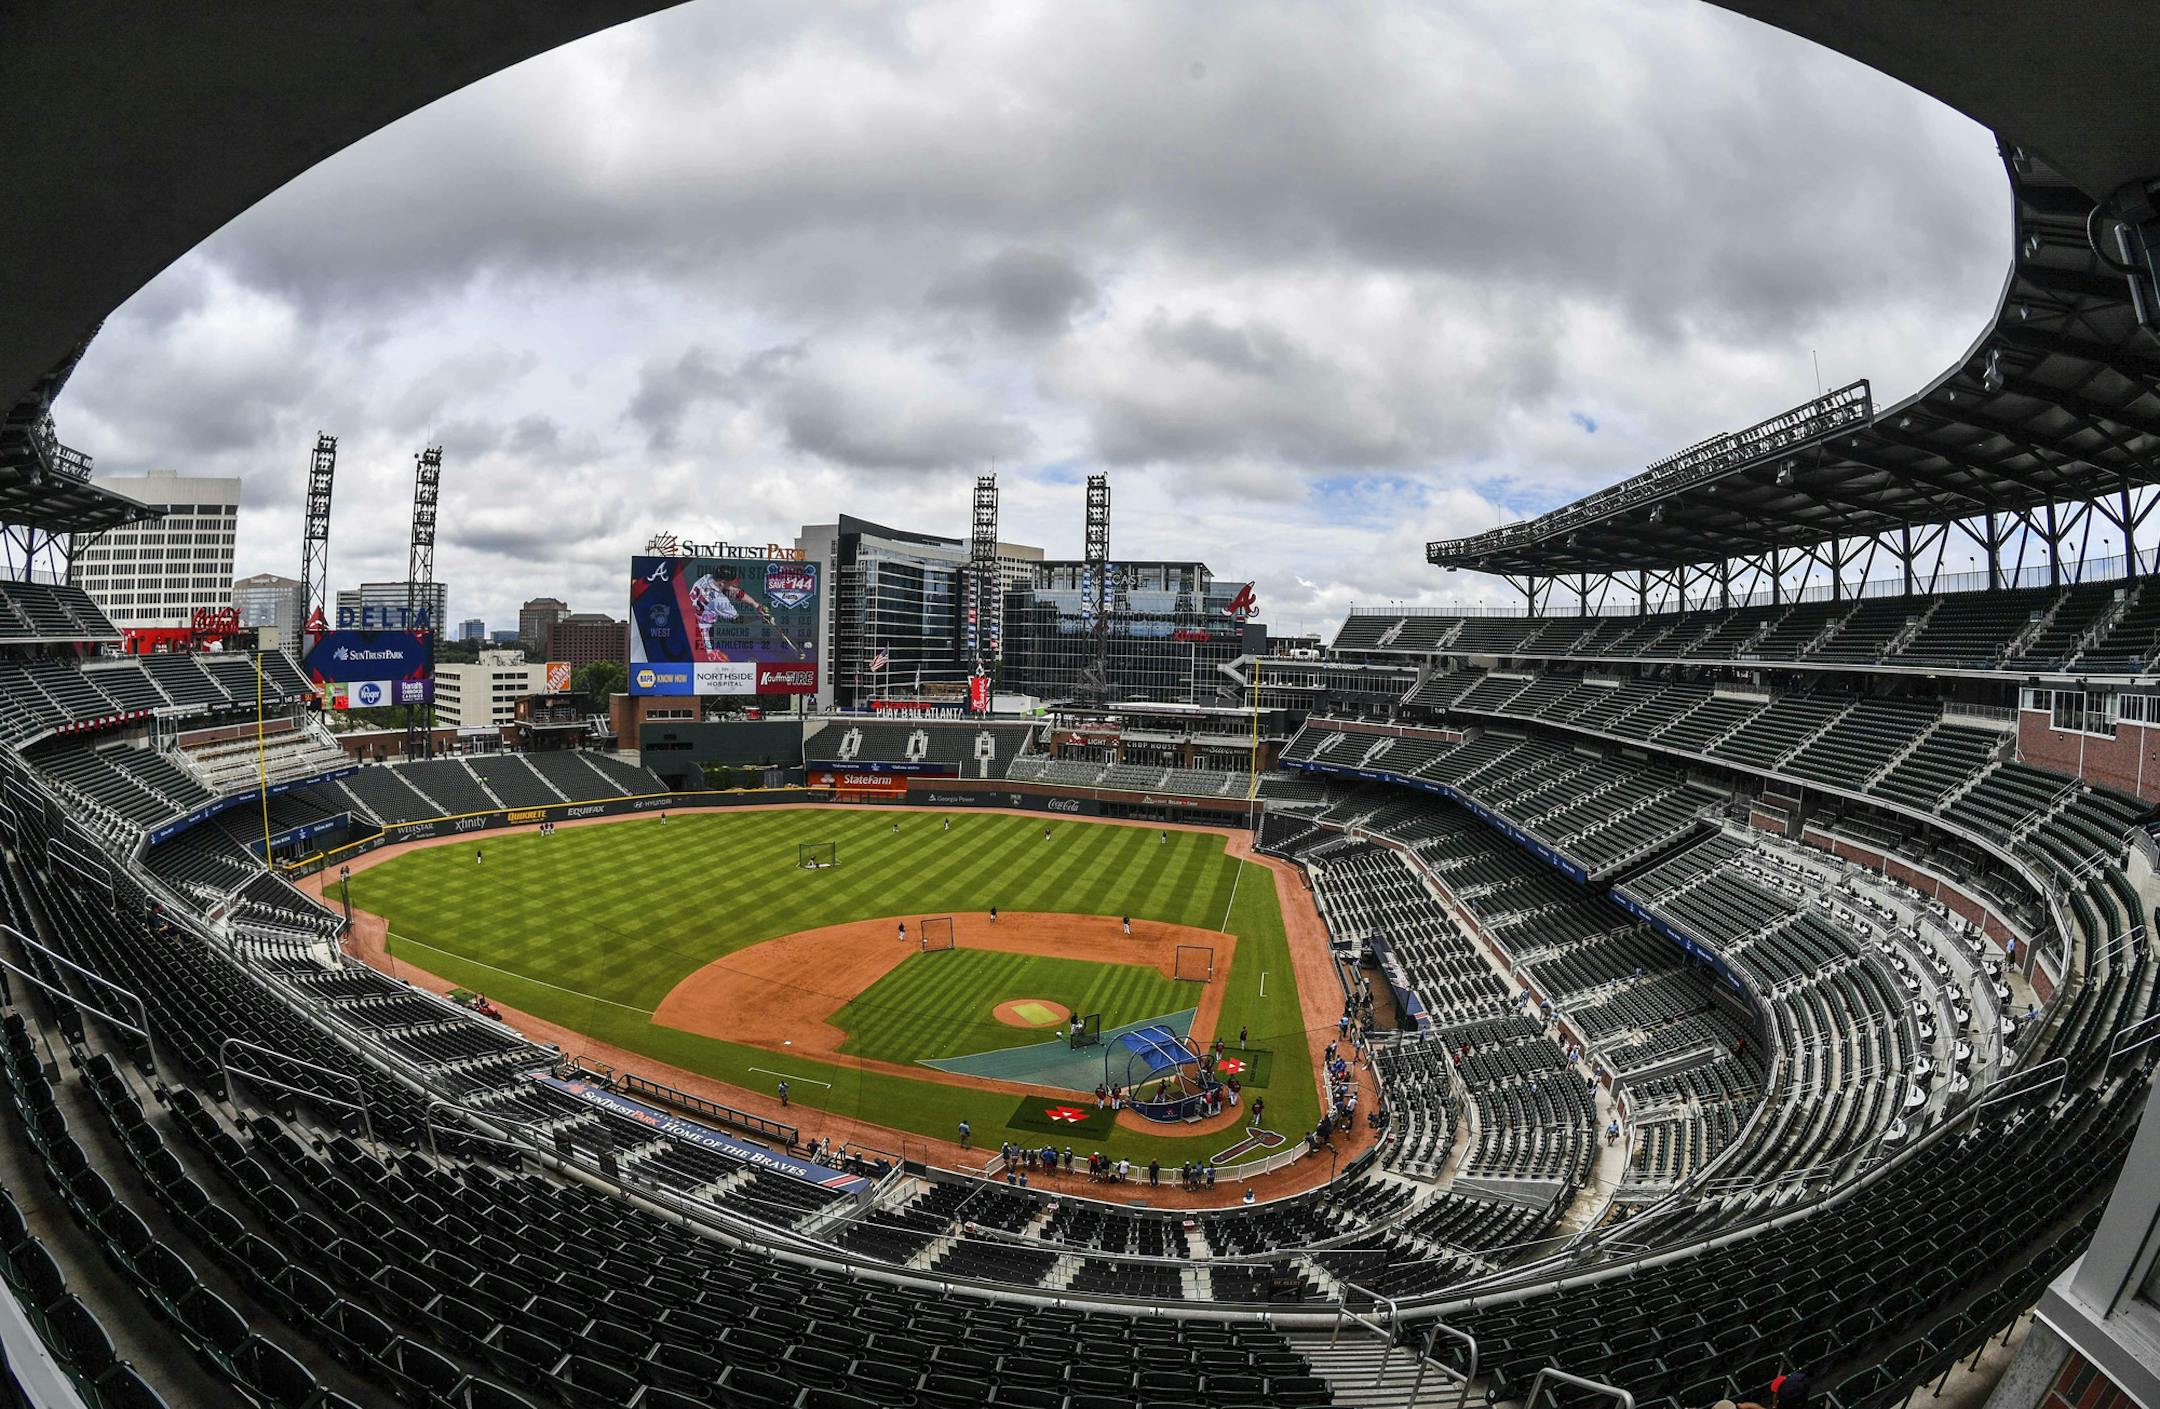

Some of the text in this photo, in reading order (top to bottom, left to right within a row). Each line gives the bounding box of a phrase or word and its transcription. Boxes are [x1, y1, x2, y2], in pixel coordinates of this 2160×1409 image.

[339, 607, 431, 627] DELTA
[697, 673, 754, 681] NORTHSIDE
[361, 686, 379, 703] Kroger
[876, 707, 898, 720] PLAY
[901, 707, 922, 720] BALL
[644, 799, 673, 807] HYUNDAI
[507, 810, 546, 821] QUIKRETE
[567, 805, 604, 817] EQUIFAX
[397, 823, 434, 834] WELLSTAR
[455, 816, 487, 833] xfinity
[660, 1121, 808, 1177] HOME OF THE BRAVES
